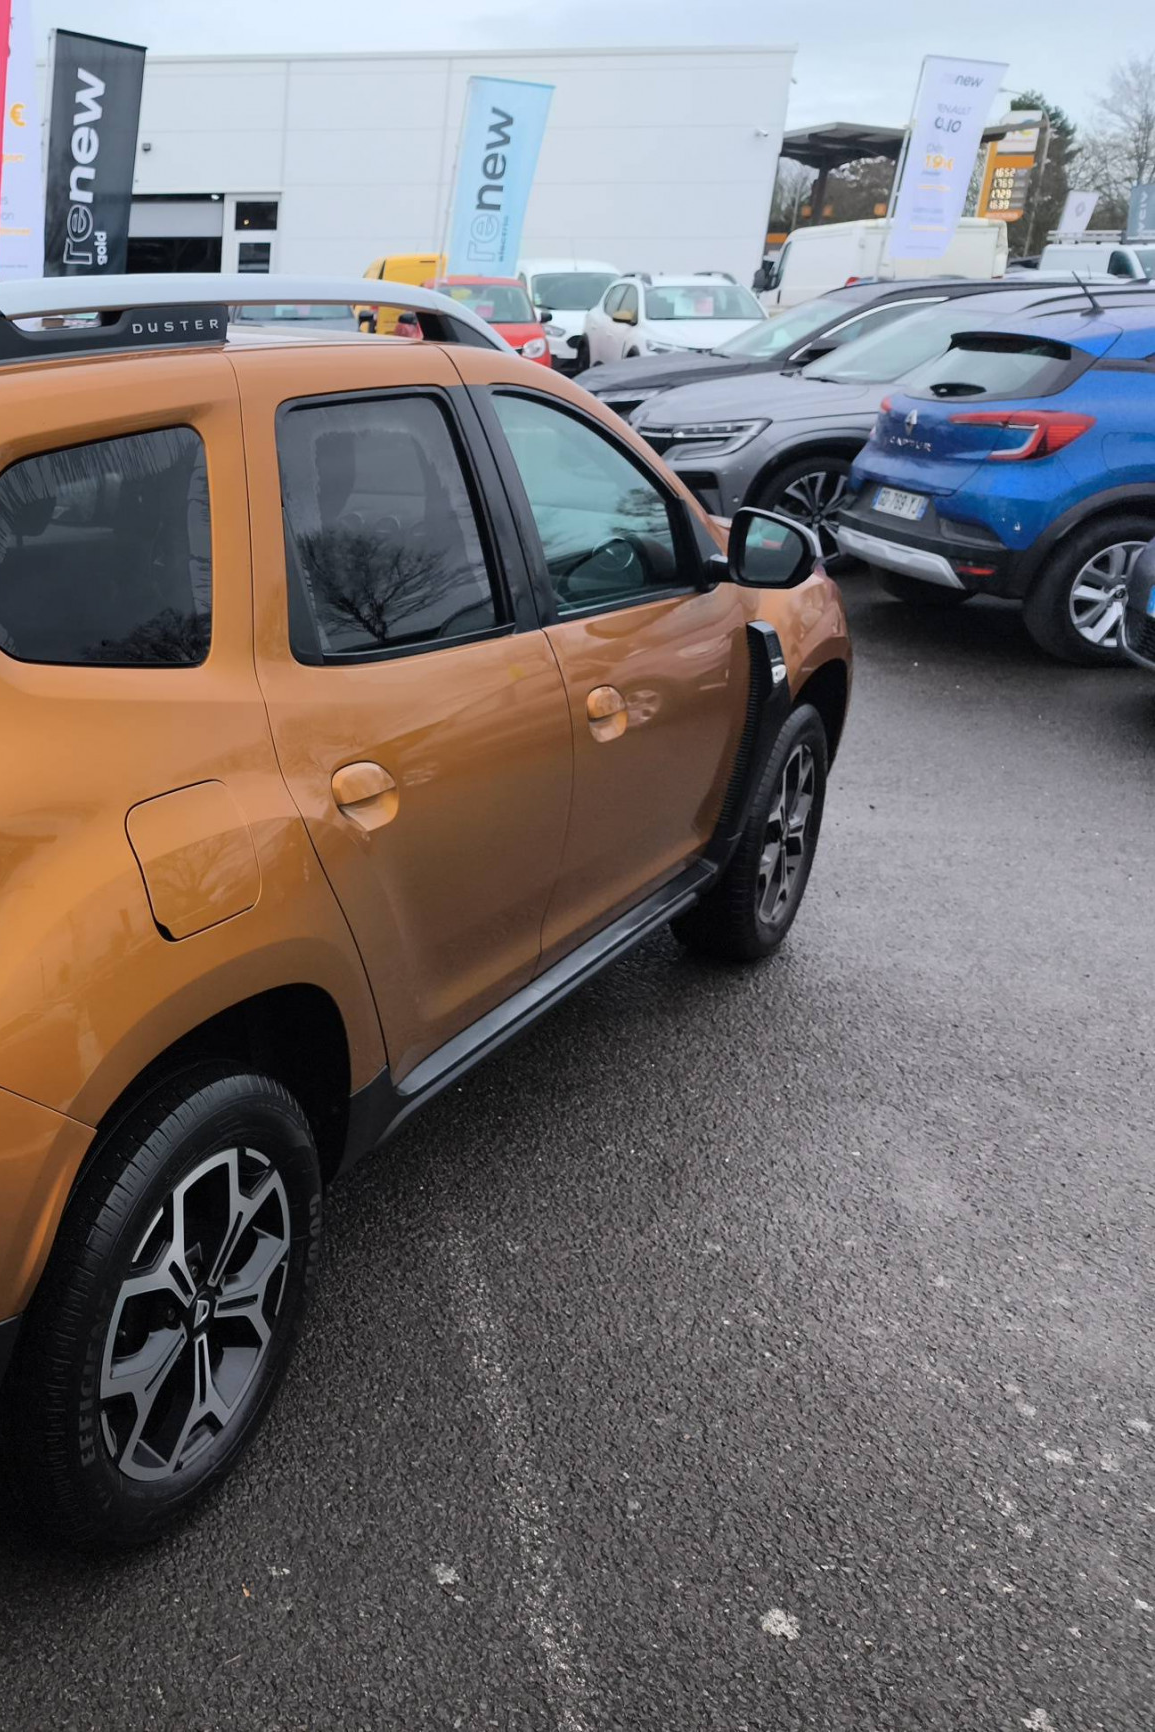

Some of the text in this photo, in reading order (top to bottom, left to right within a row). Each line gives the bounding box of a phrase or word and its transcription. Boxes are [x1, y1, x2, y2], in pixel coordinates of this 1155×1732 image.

[63, 67, 106, 265] renew
[467, 106, 514, 262] renew
[94, 231, 108, 265] gold
[132, 319, 219, 334] DUSTER
